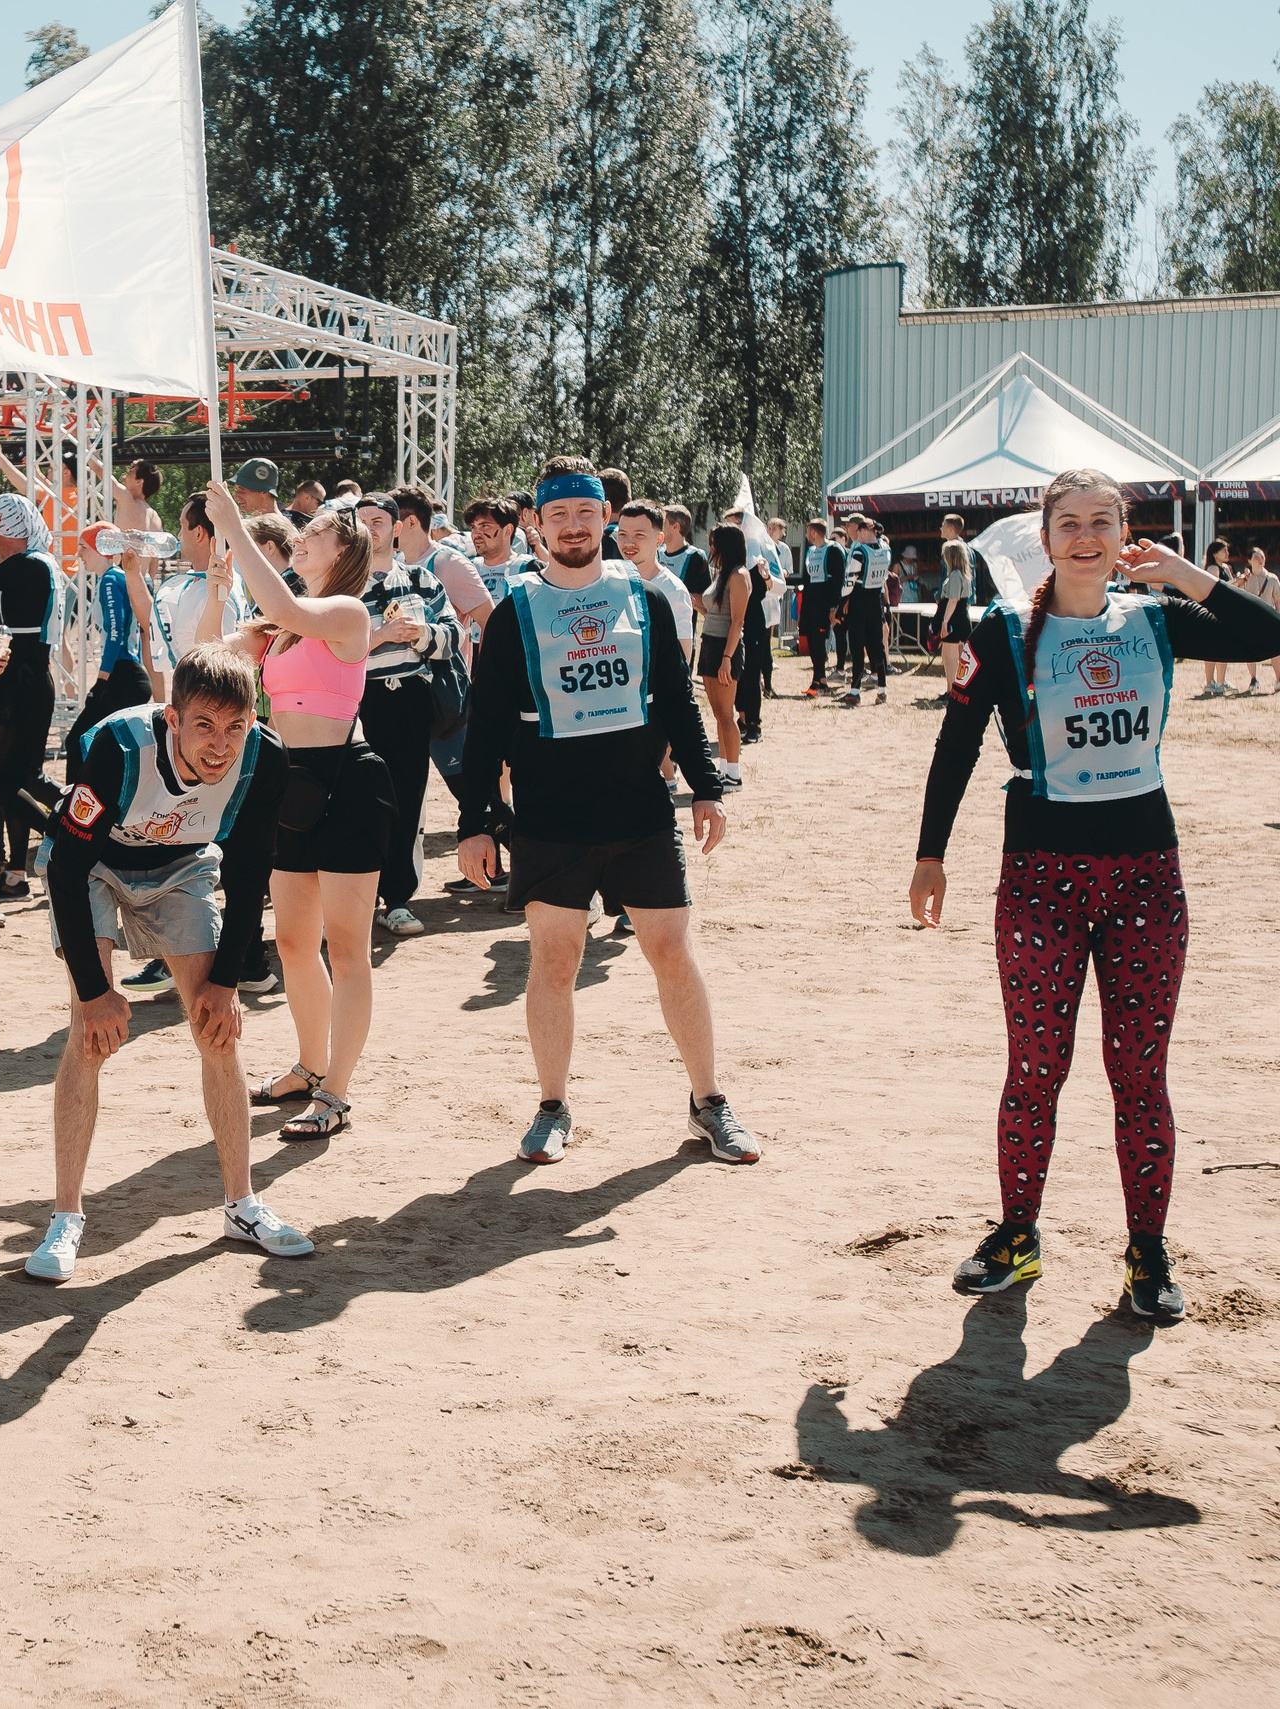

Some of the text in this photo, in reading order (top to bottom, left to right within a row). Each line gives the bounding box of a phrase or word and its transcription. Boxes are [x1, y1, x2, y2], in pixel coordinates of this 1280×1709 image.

[1217, 481, 1248, 489] ГОНКА
[835, 495, 862, 503] ГОНКА
[924, 486, 1043, 508] РЕГИСТРАЦ
[1215, 489, 1250, 499] ГЕРОЕВ
[834, 503, 864, 511] ГЕРОЕВ
[558, 600, 609, 616] ГОНКА ГЕРОЕВ
[1061, 635, 1122, 648] ГОНКА ГЕРОЕВ
[567, 644, 618, 661] ПИВТОЧКА
[559, 658, 630, 694] 5299
[1074, 689, 1139, 709] ПИВТОЧКА
[588, 706, 628, 718] ГАЗПРОМБАНК
[1064, 705, 1150, 750] 5304
[1096, 766, 1142, 781] ГАЗПРОМБАНК
